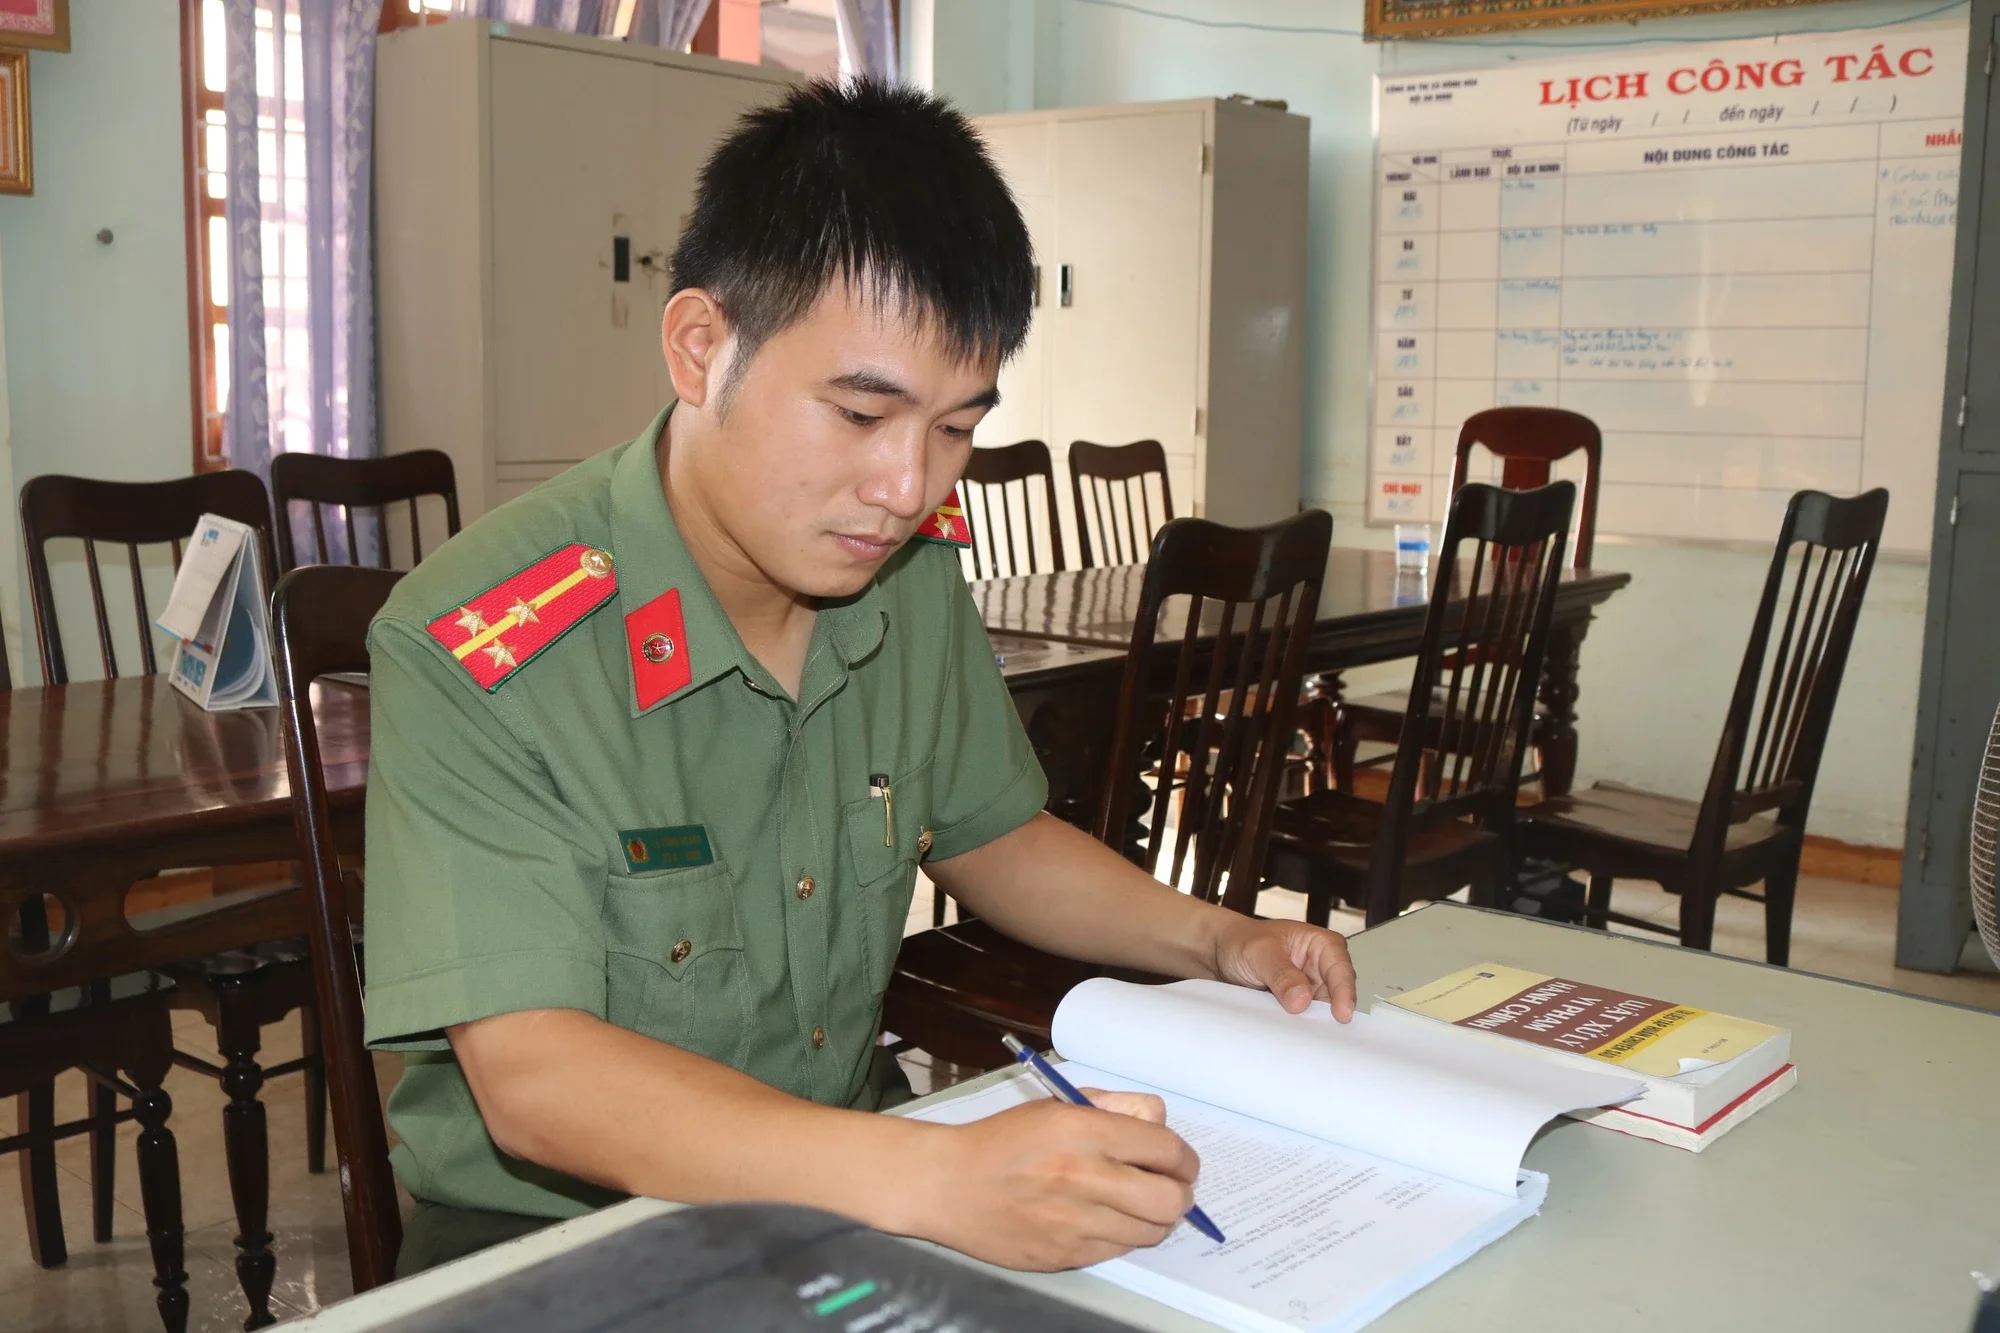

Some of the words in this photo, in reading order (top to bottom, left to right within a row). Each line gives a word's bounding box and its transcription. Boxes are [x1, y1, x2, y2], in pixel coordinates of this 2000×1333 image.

[1538, 71, 1649, 109] LỊCH
[1666, 58, 1806, 95] CÔNG
[1824, 44, 1934, 83] TÁC
[1591, 115, 1624, 135] ngày
[1719, 104, 1745, 122] đến
[1749, 103, 1785, 122] ngày
[1644, 150, 1668, 164] NỘI
[1673, 148, 1712, 162] DUNG
[1717, 143, 1757, 159] CÔNG
[1763, 142, 1790, 157] TÁC
[1518, 981, 1578, 1006] HÀNH
[1569, 996, 1603, 1007] VI
[1466, 1003, 1532, 1030] CHÍNH
[1521, 1003, 1586, 1033] PHẠM
[1599, 999, 1653, 1023] LUẬT
[1553, 1032, 1590, 1049] LÝ
[1574, 1019, 1614, 1039] XỬ
